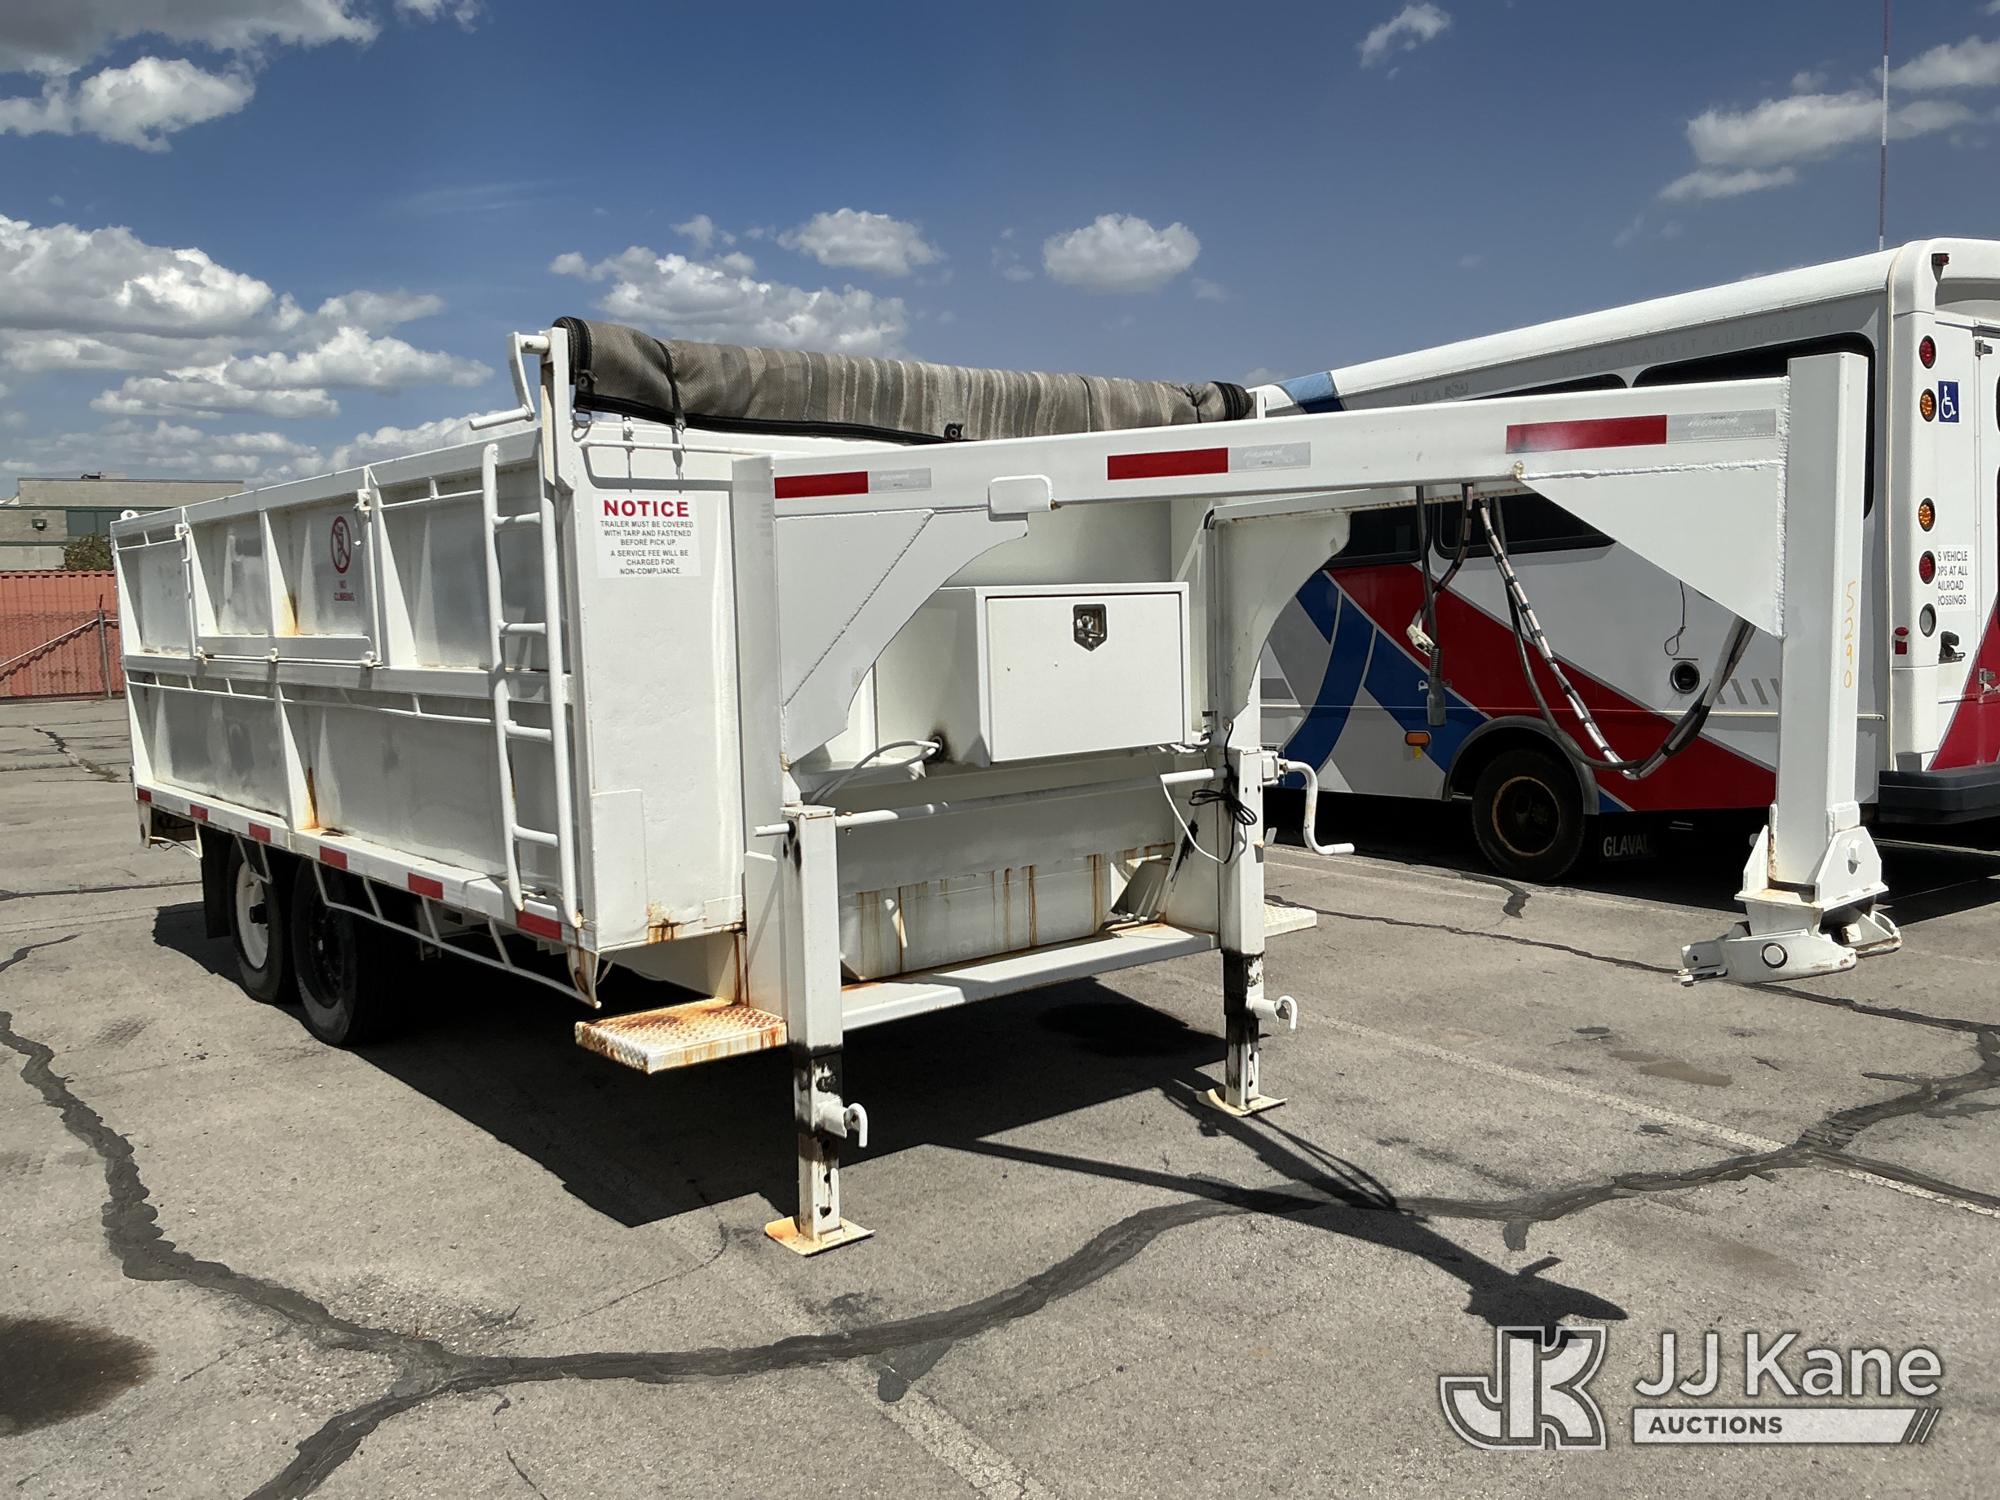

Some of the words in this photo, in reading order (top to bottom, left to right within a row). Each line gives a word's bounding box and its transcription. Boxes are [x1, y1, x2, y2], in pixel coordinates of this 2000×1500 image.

[604, 500, 690, 517] NOTICE
[600, 520, 630, 528] TRAILER
[1943, 551, 1968, 561] VEHICLE
[1949, 566, 1957, 576] AT
[1958, 566, 1968, 576] ALL
